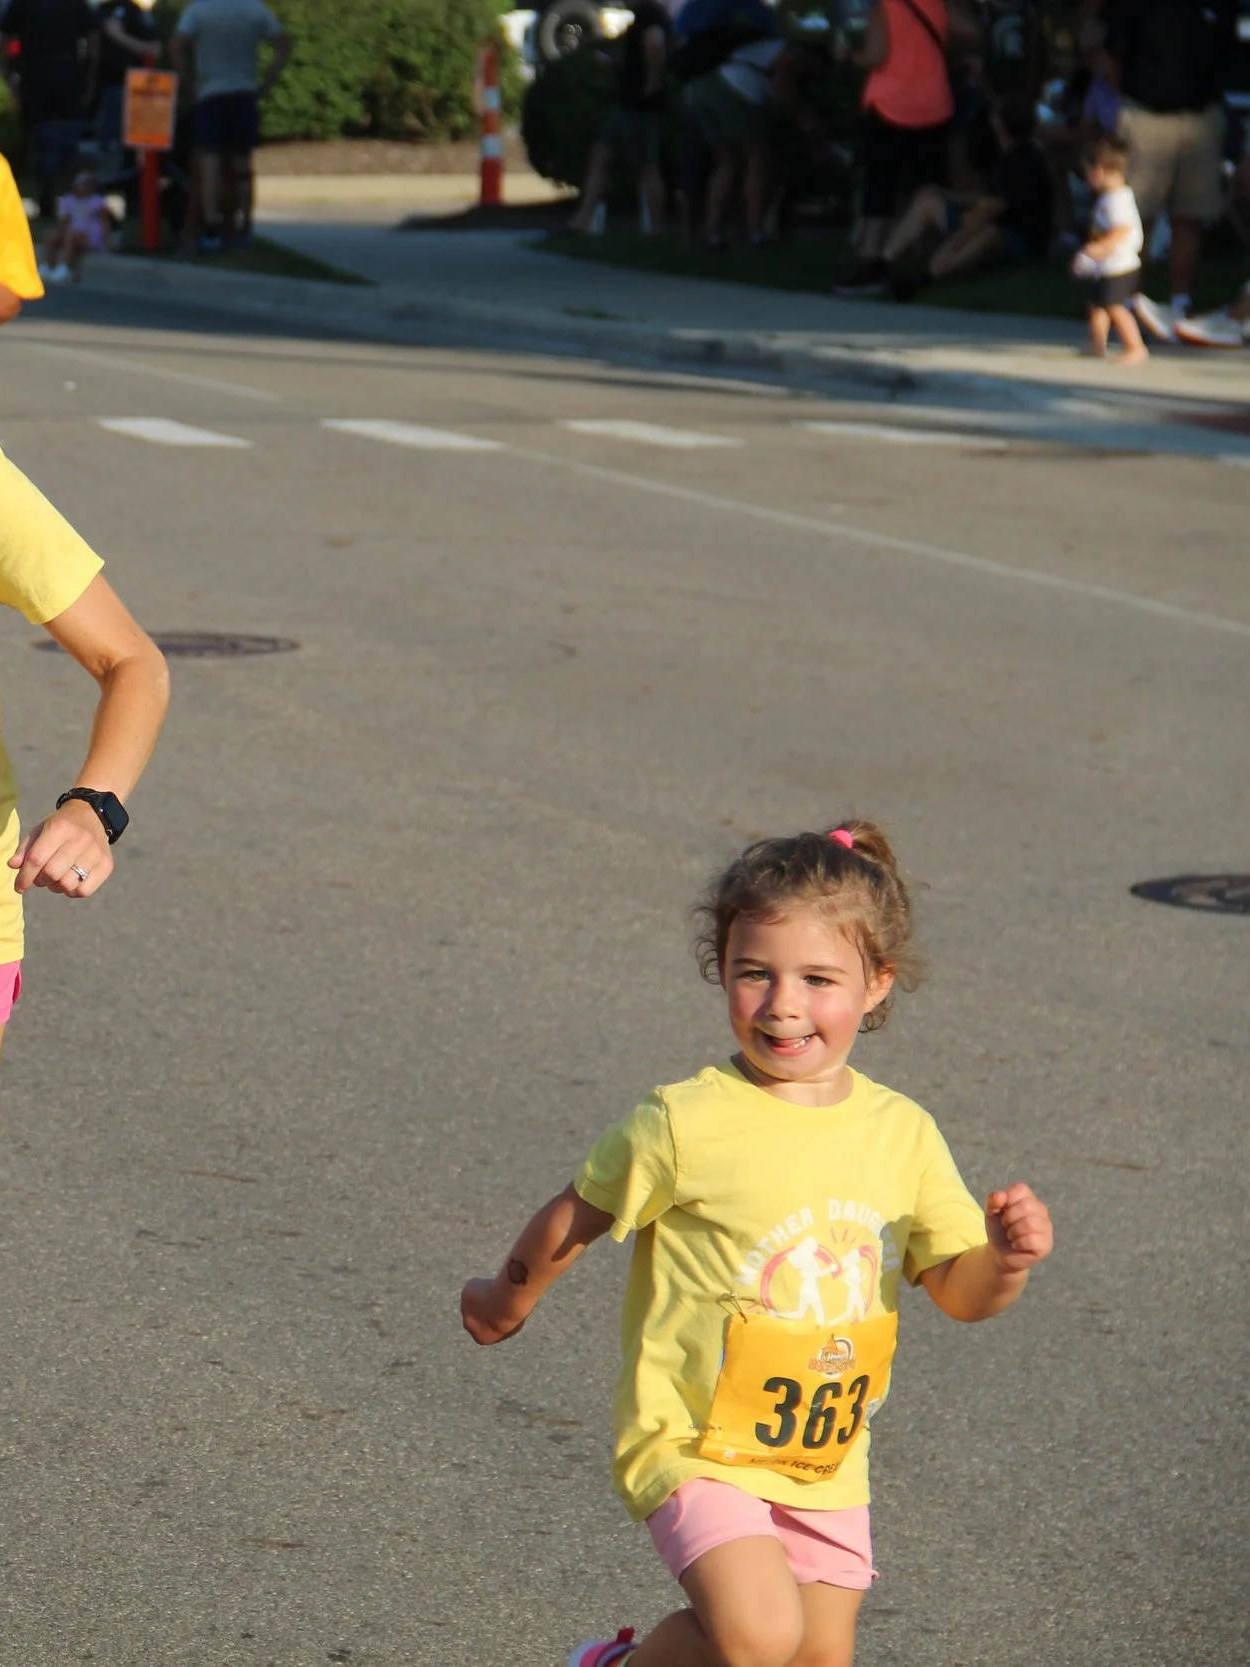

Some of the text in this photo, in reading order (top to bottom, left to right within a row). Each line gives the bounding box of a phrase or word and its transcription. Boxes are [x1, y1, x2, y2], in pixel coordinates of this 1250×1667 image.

[733, 1207, 814, 1287] MOTHER
[755, 1374, 871, 1450] 363
[790, 1460, 814, 1471] ICE
